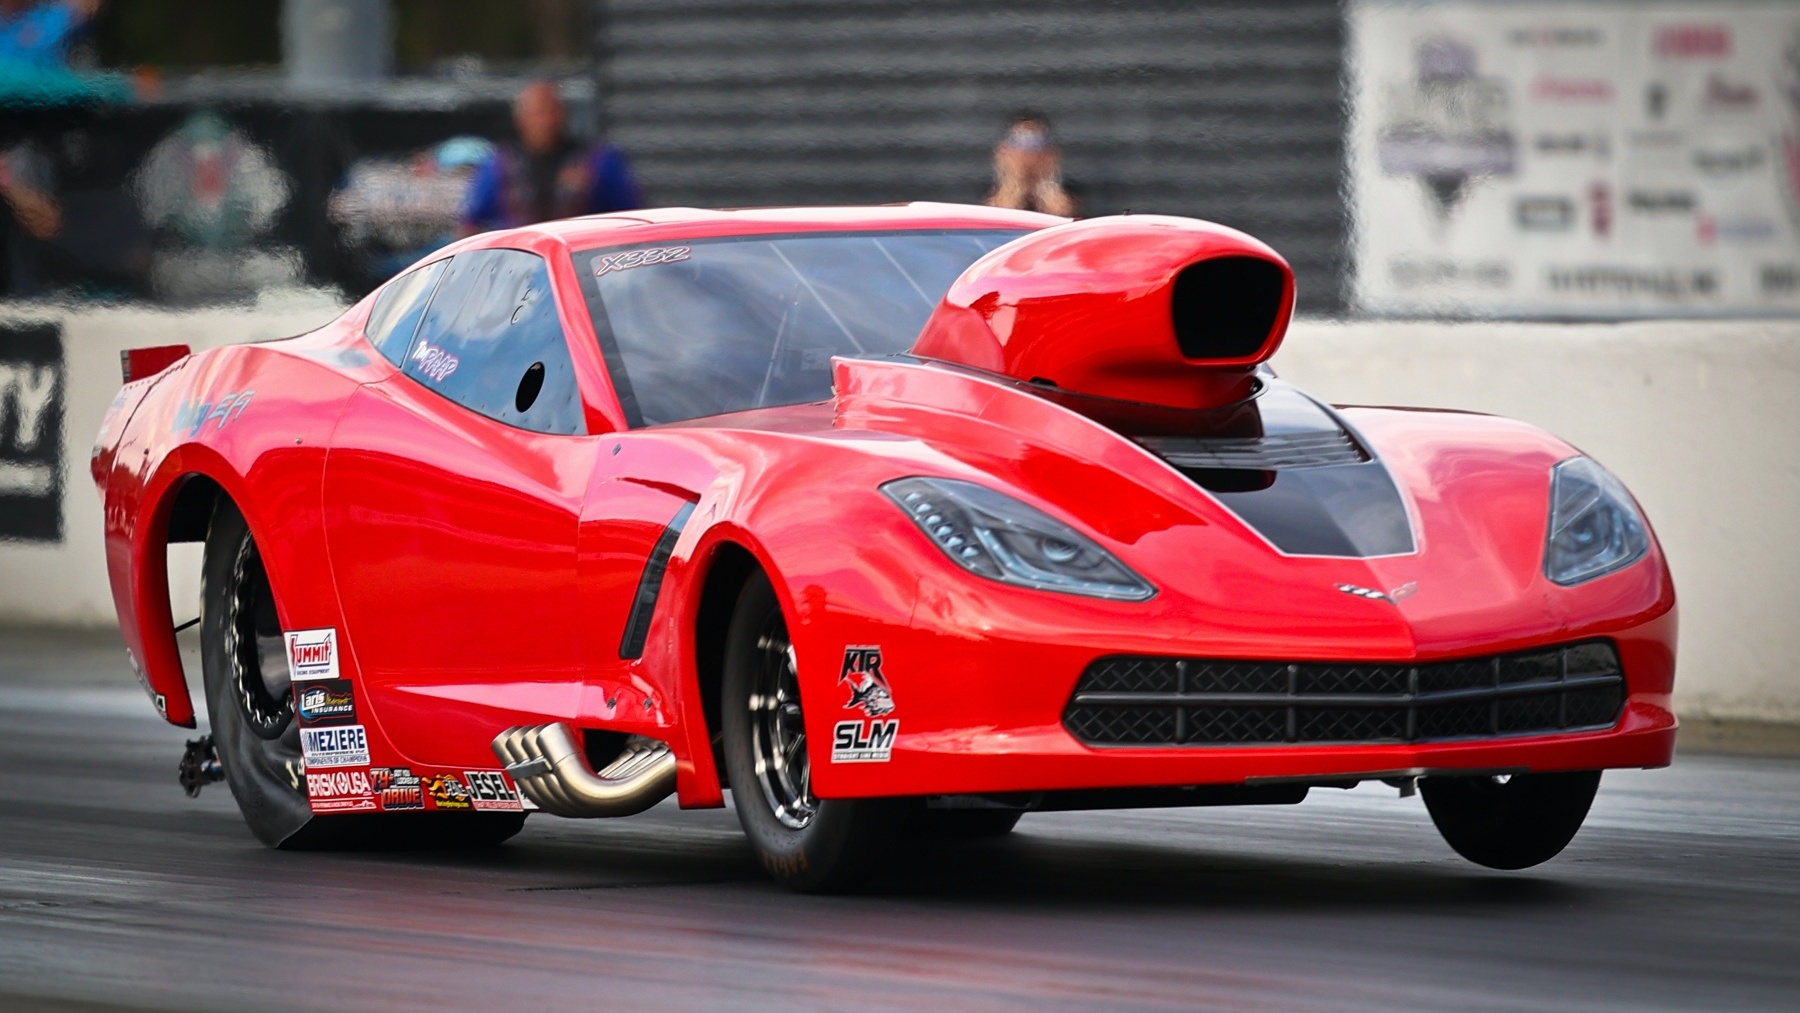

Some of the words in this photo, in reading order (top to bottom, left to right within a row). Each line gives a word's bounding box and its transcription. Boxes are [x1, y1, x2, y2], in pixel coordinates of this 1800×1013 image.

[593, 245, 692, 277] X332
[839, 648, 888, 688] KTR
[300, 690, 326, 711] Laris
[310, 704, 353, 714] INSURANCE
[306, 728, 366, 752] MEZIERE
[835, 722, 897, 750] SLM
[306, 773, 340, 796] BRISK
[347, 771, 372, 794] USA
[465, 773, 518, 801] JESEL
[382, 788, 421, 806] DRIVE
